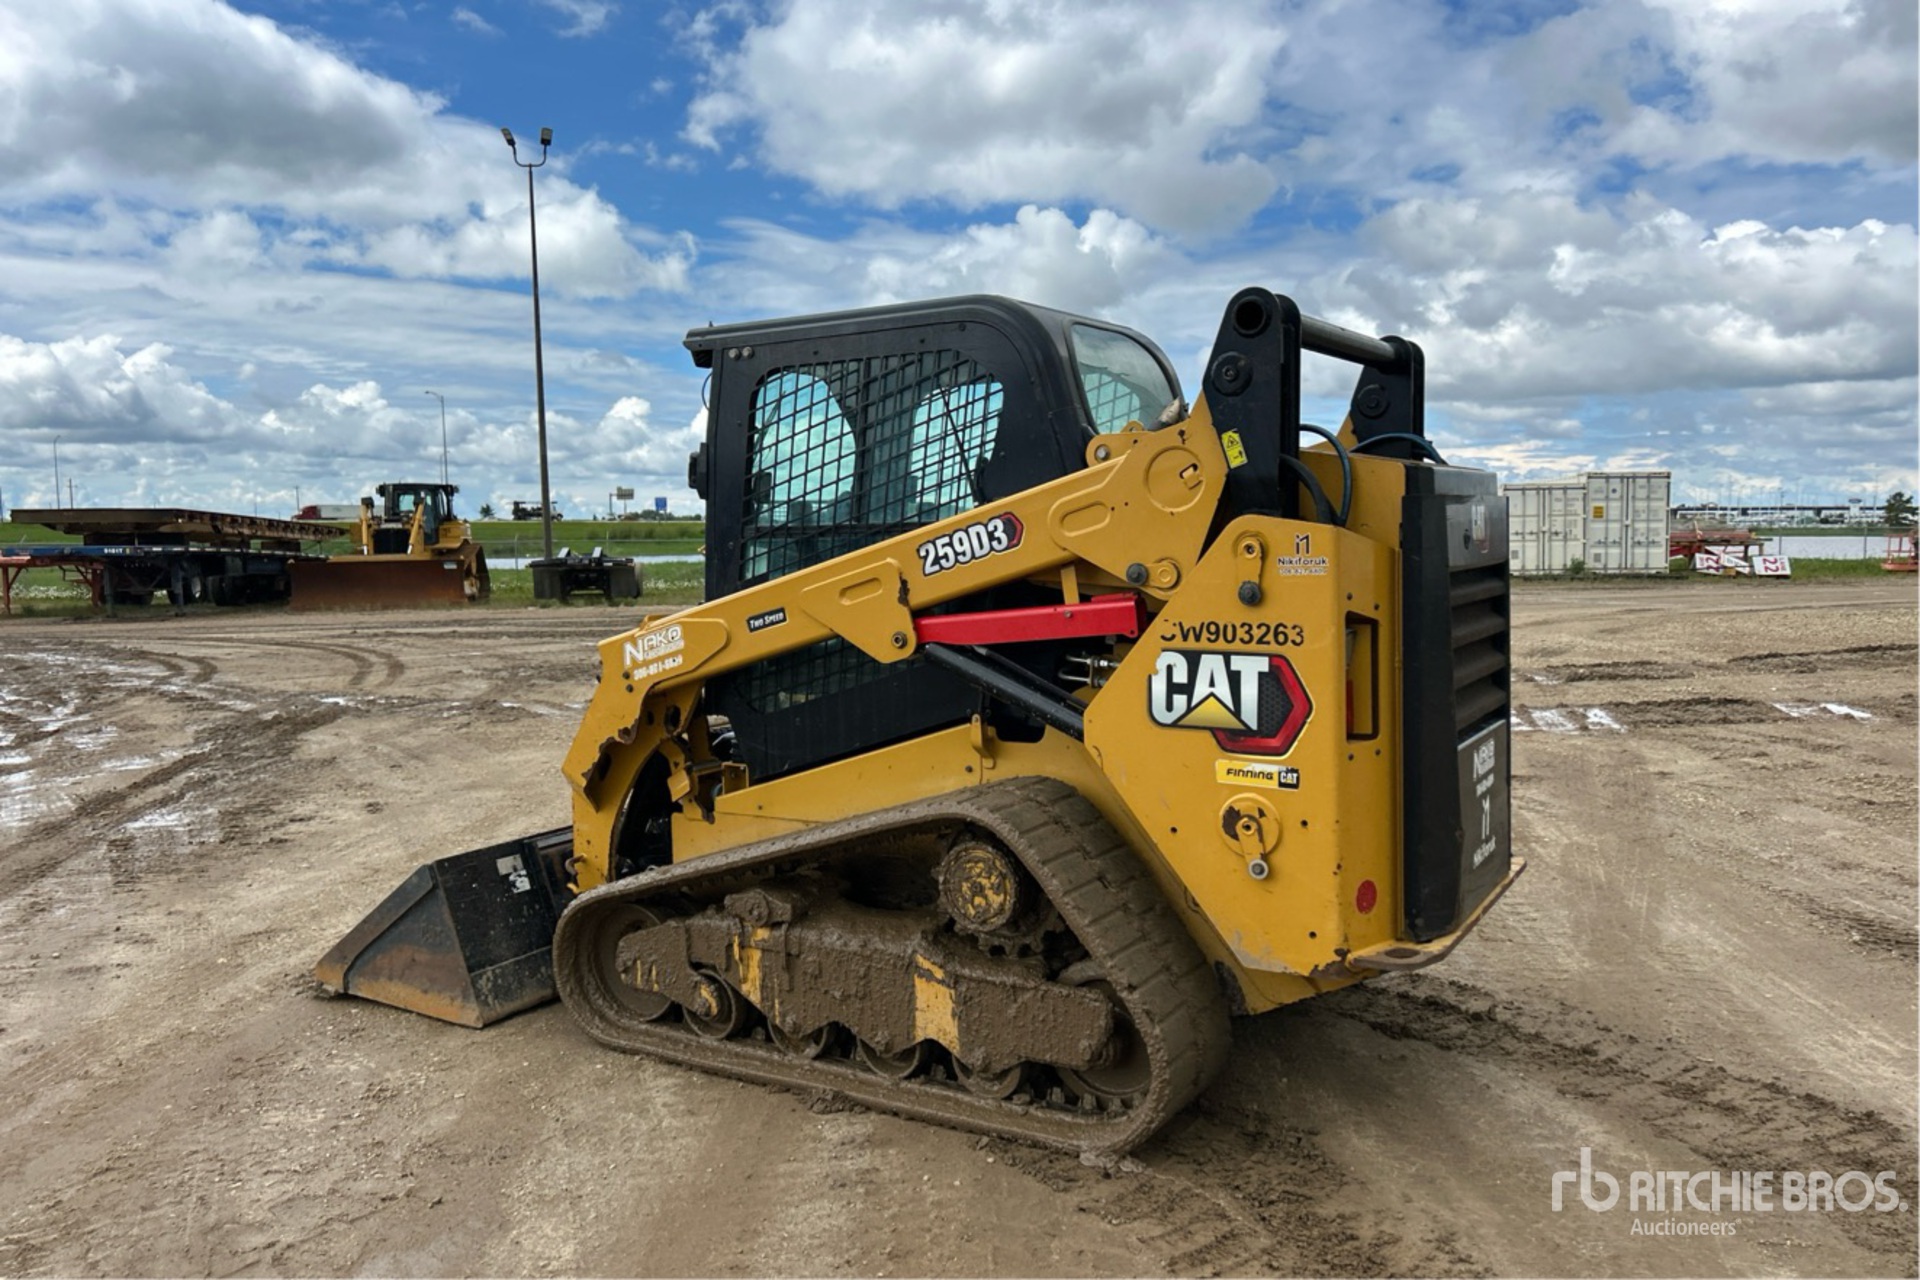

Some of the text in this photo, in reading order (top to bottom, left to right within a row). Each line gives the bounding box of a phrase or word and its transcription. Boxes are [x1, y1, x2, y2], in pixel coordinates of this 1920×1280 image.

[919, 517, 1009, 576] 259D3
[1277, 556, 1328, 567] Nikiforuk
[1762, 557, 1780, 573] 22
[1151, 650, 1270, 731] CAT
[1279, 770, 1298, 784] CAT
